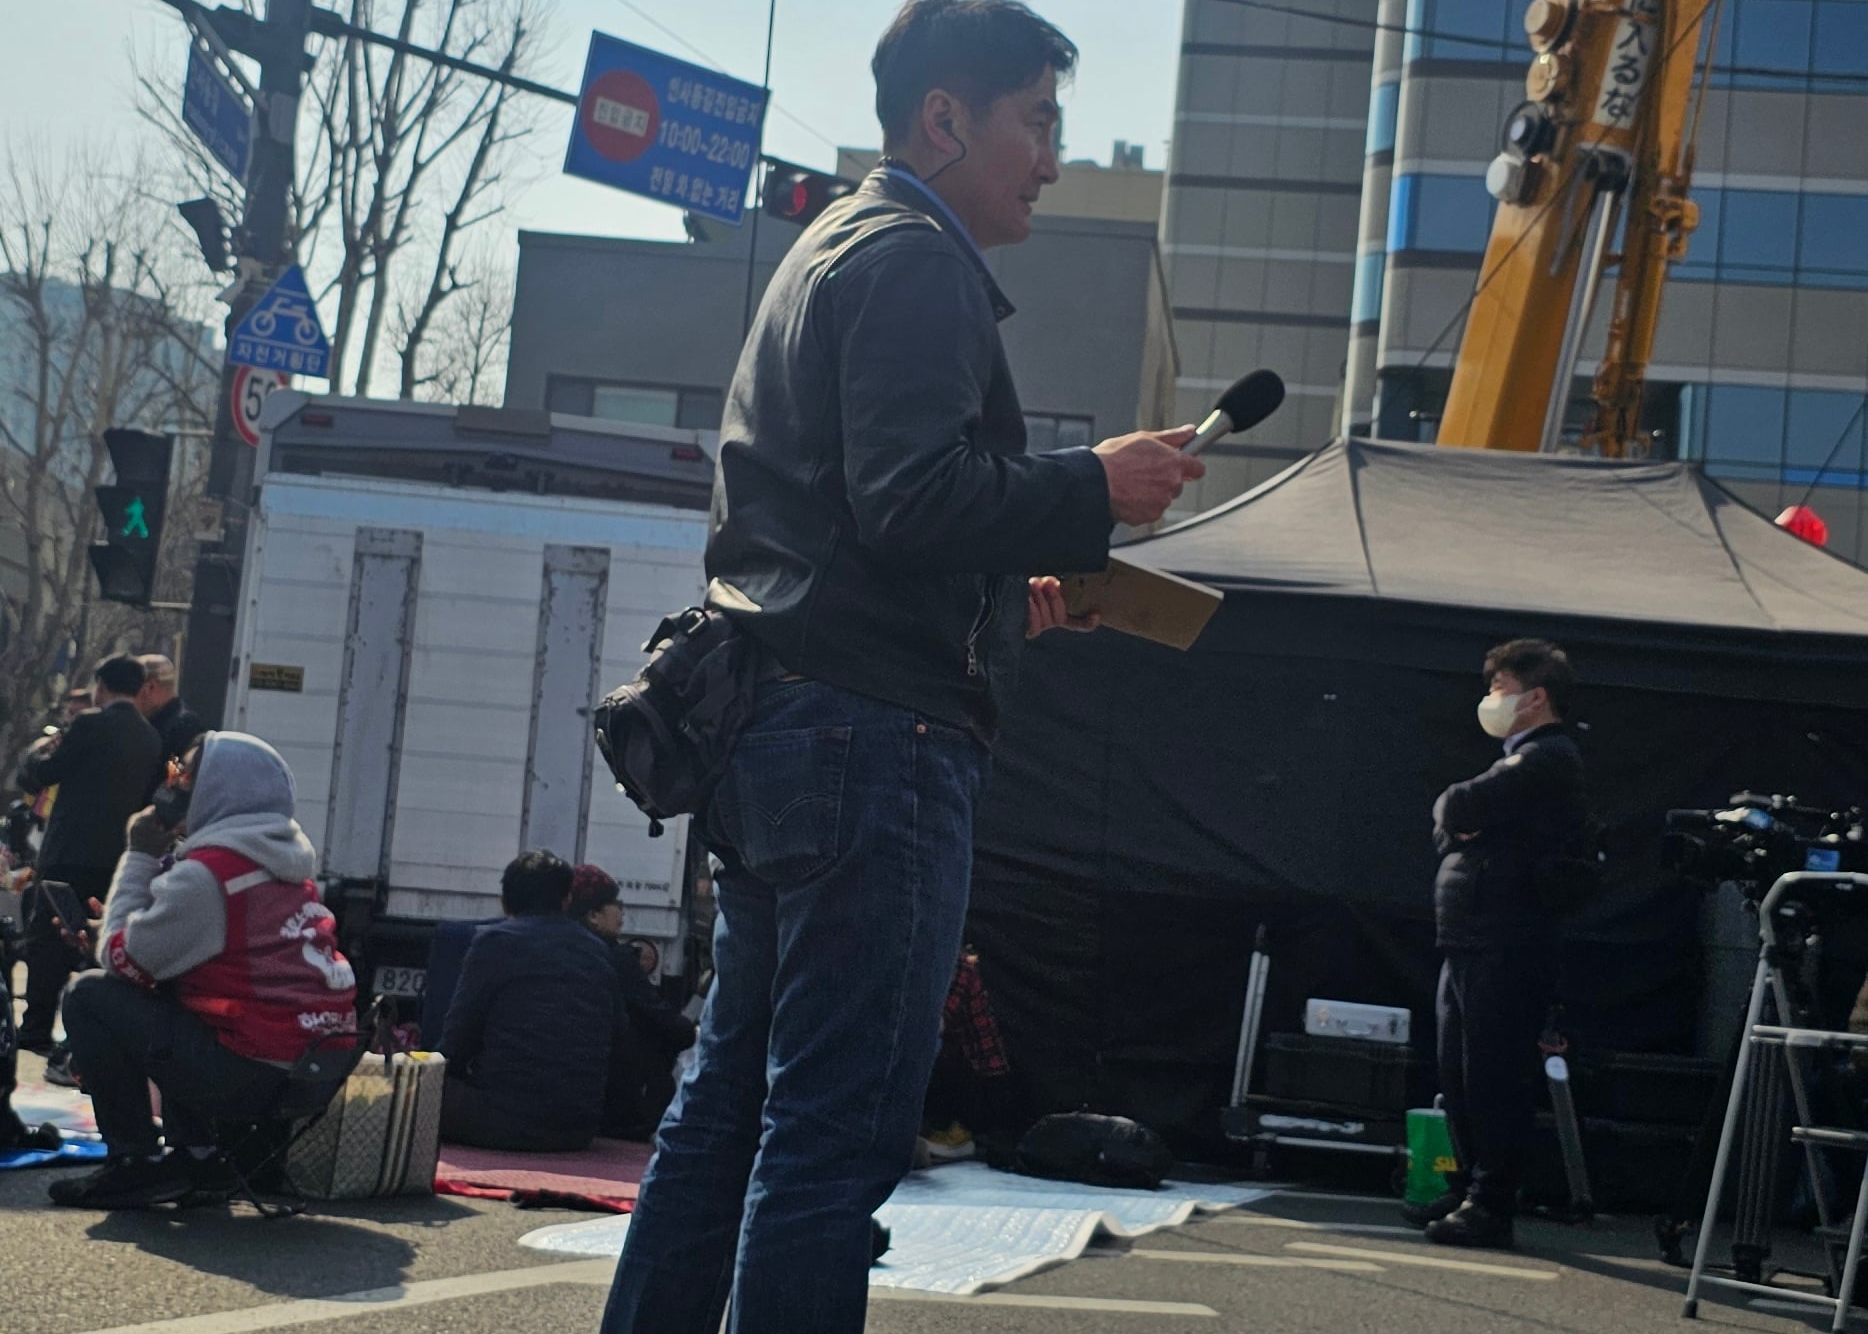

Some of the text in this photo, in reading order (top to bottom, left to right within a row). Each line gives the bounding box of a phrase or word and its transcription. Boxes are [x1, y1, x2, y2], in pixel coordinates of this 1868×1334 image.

[659, 120, 750, 169] 10:00~22:00
[714, 185, 741, 214] 거리
[238, 342, 321, 373] 자전거횡단
